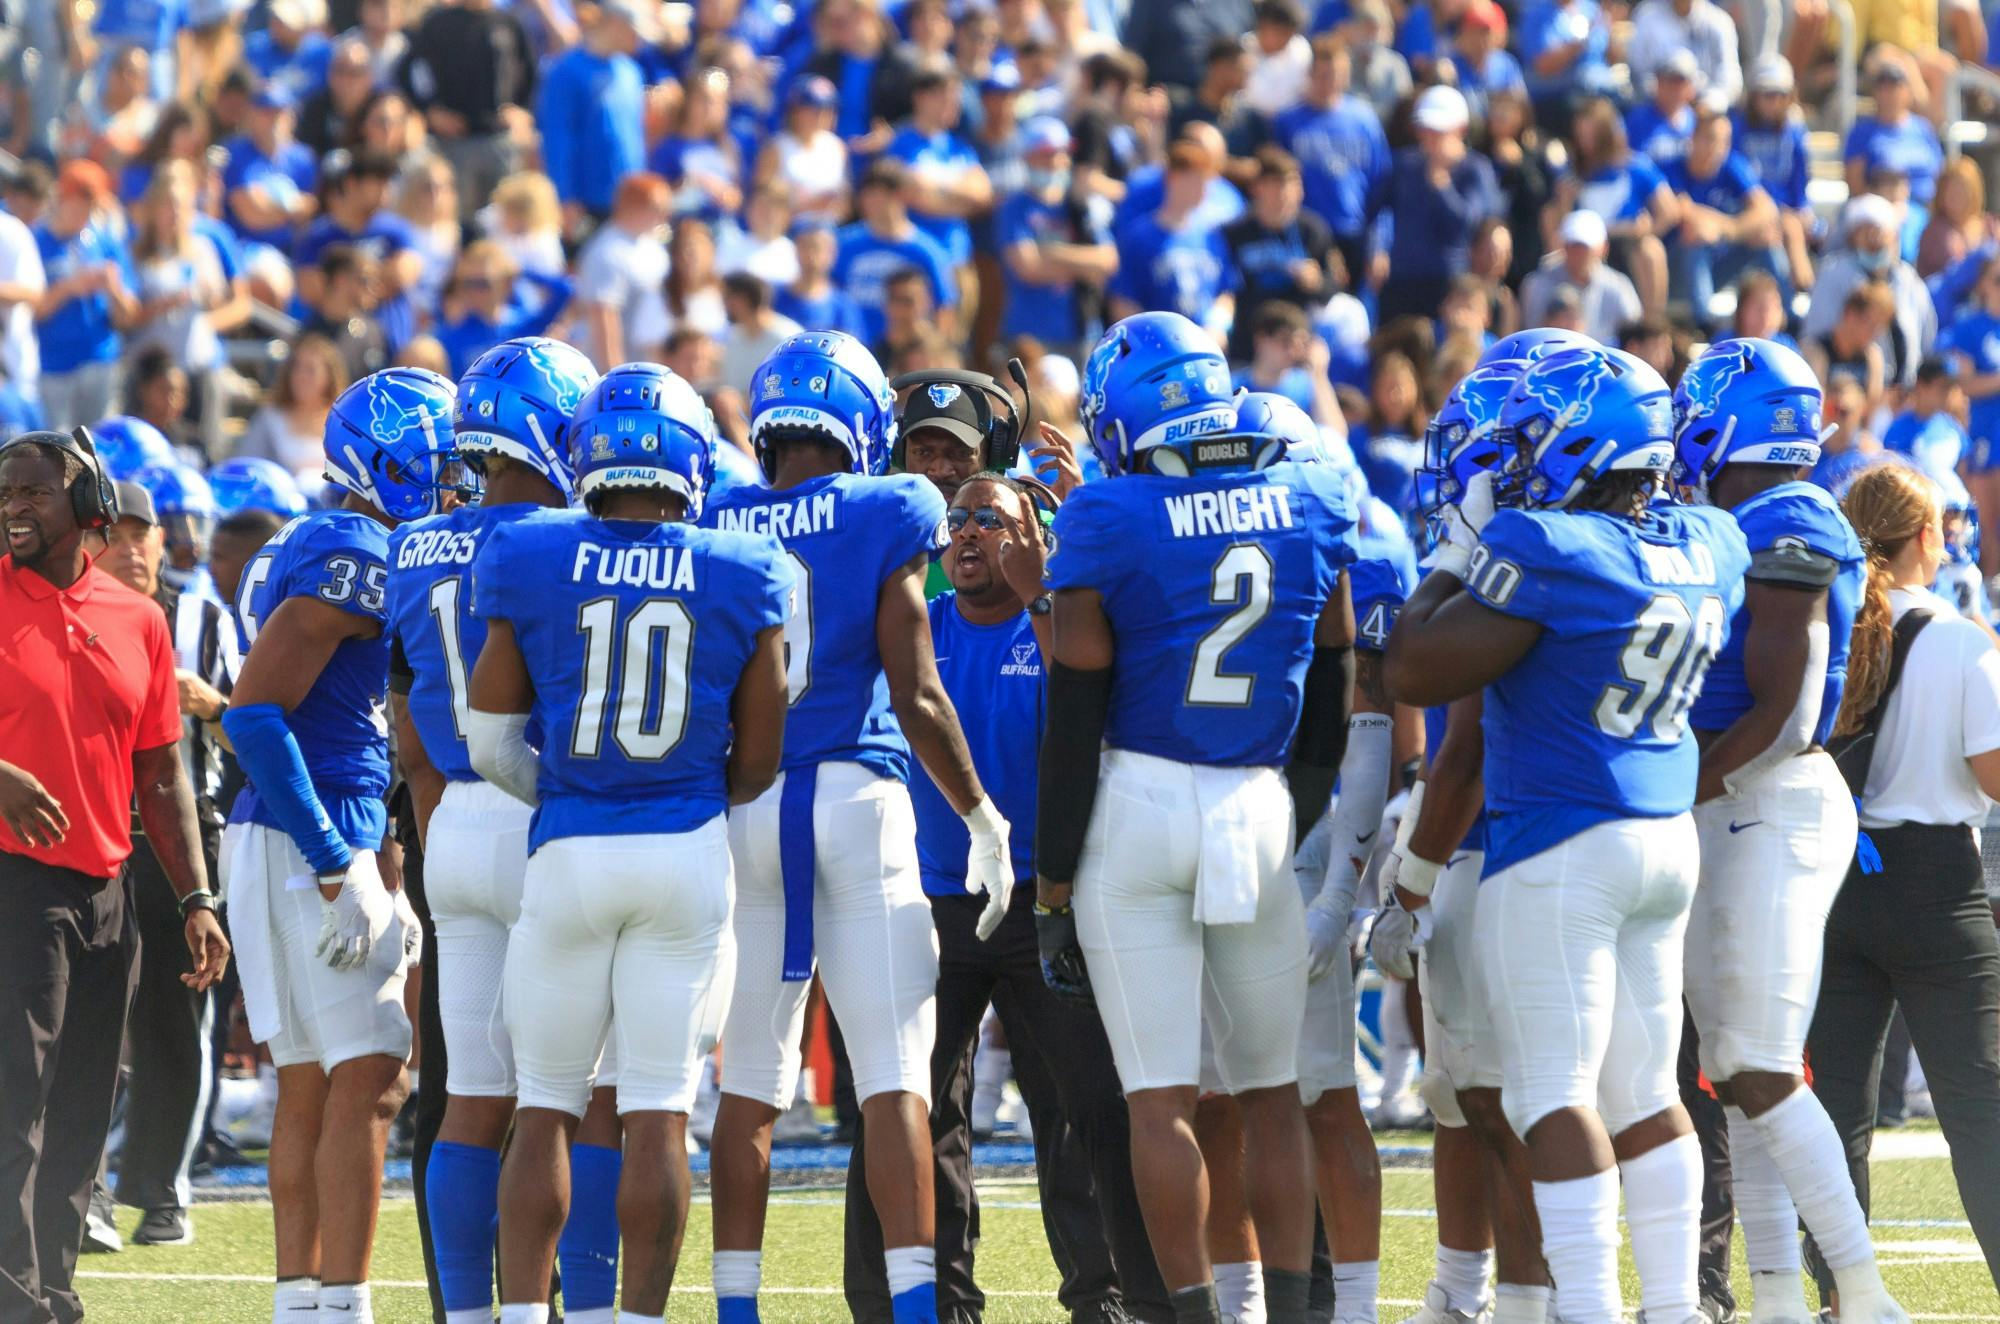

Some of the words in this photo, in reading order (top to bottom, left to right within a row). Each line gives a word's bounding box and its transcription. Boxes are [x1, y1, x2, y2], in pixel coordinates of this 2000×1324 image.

[617, 416, 636, 433] 10
[773, 408, 820, 421] BUFFALO
[1198, 442, 1248, 462] DOUGLAS
[605, 470, 657, 481] BUFFALO
[717, 493, 836, 539] INGRAM
[1164, 486, 1295, 537] WRIGHT
[397, 527, 483, 569] GROSS
[572, 541, 696, 592] FUQUA
[319, 554, 389, 614] 35
[1463, 543, 1524, 606] 90
[1183, 541, 1275, 709] 2
[569, 595, 696, 763] 10
[1000, 664, 1040, 676] BUFFALO
[1593, 593, 1727, 745] 90
[1358, 719, 1388, 729] NIKE
